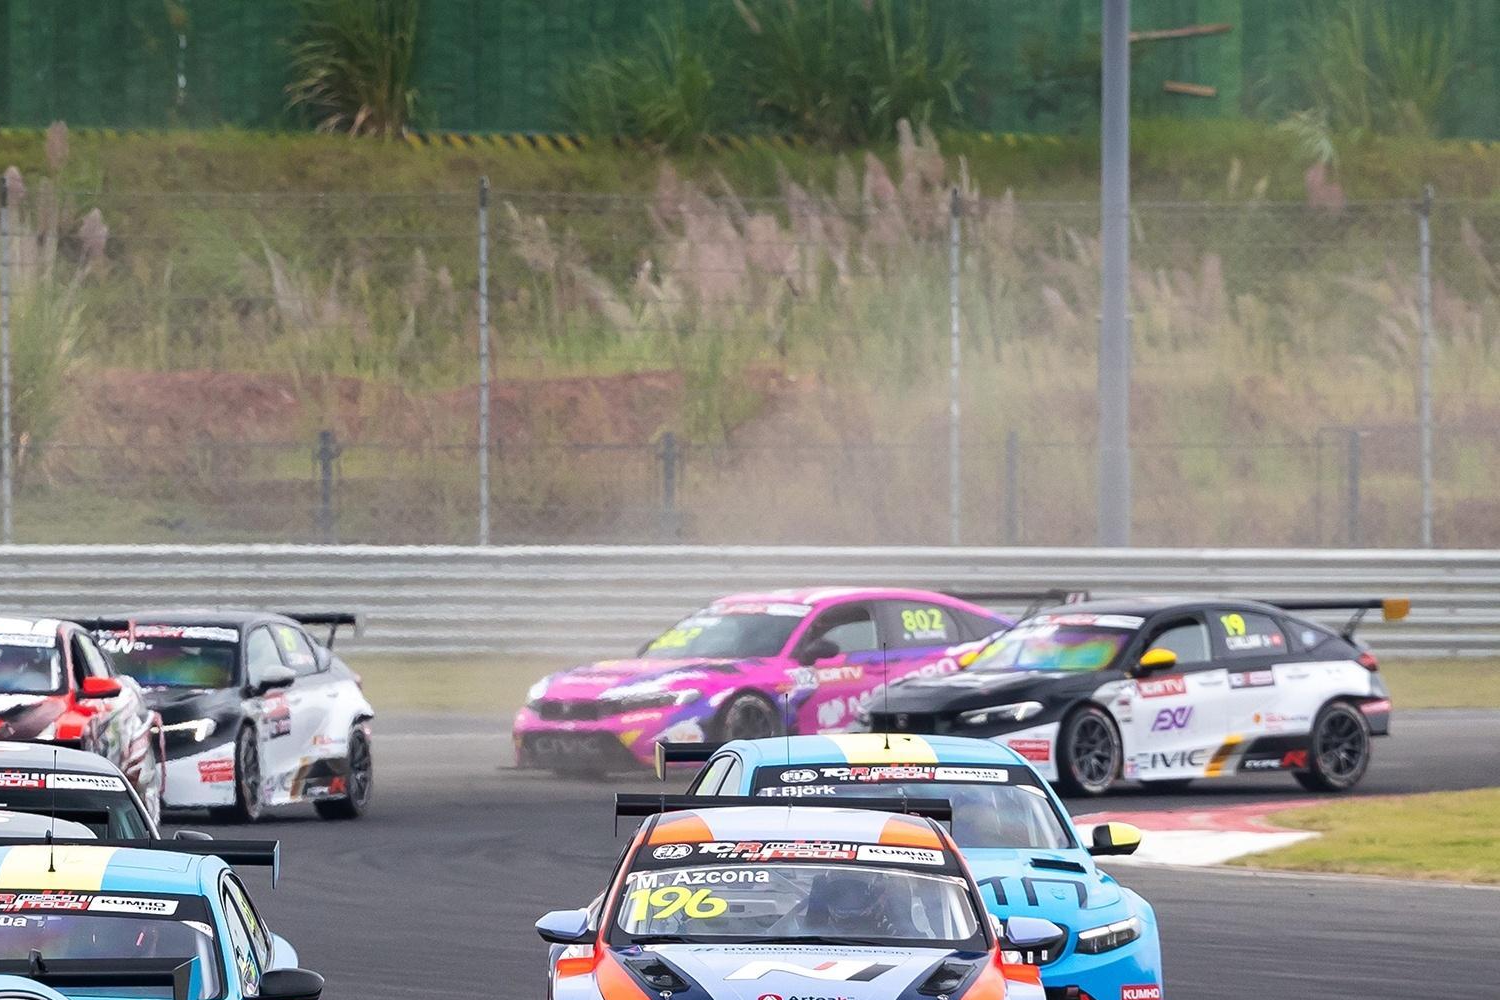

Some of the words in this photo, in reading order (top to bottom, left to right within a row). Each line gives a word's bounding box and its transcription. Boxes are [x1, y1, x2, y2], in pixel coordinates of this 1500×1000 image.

[901, 607, 945, 631] 802
[1220, 613, 1246, 636] 19
[868, 848, 934, 857] KUMHO
[636, 873, 663, 889] M.
[671, 870, 770, 887] Azcona
[100, 898, 167, 908] KUMHO
[629, 886, 729, 922] 196
[1123, 988, 1160, 1000] KUMHO
